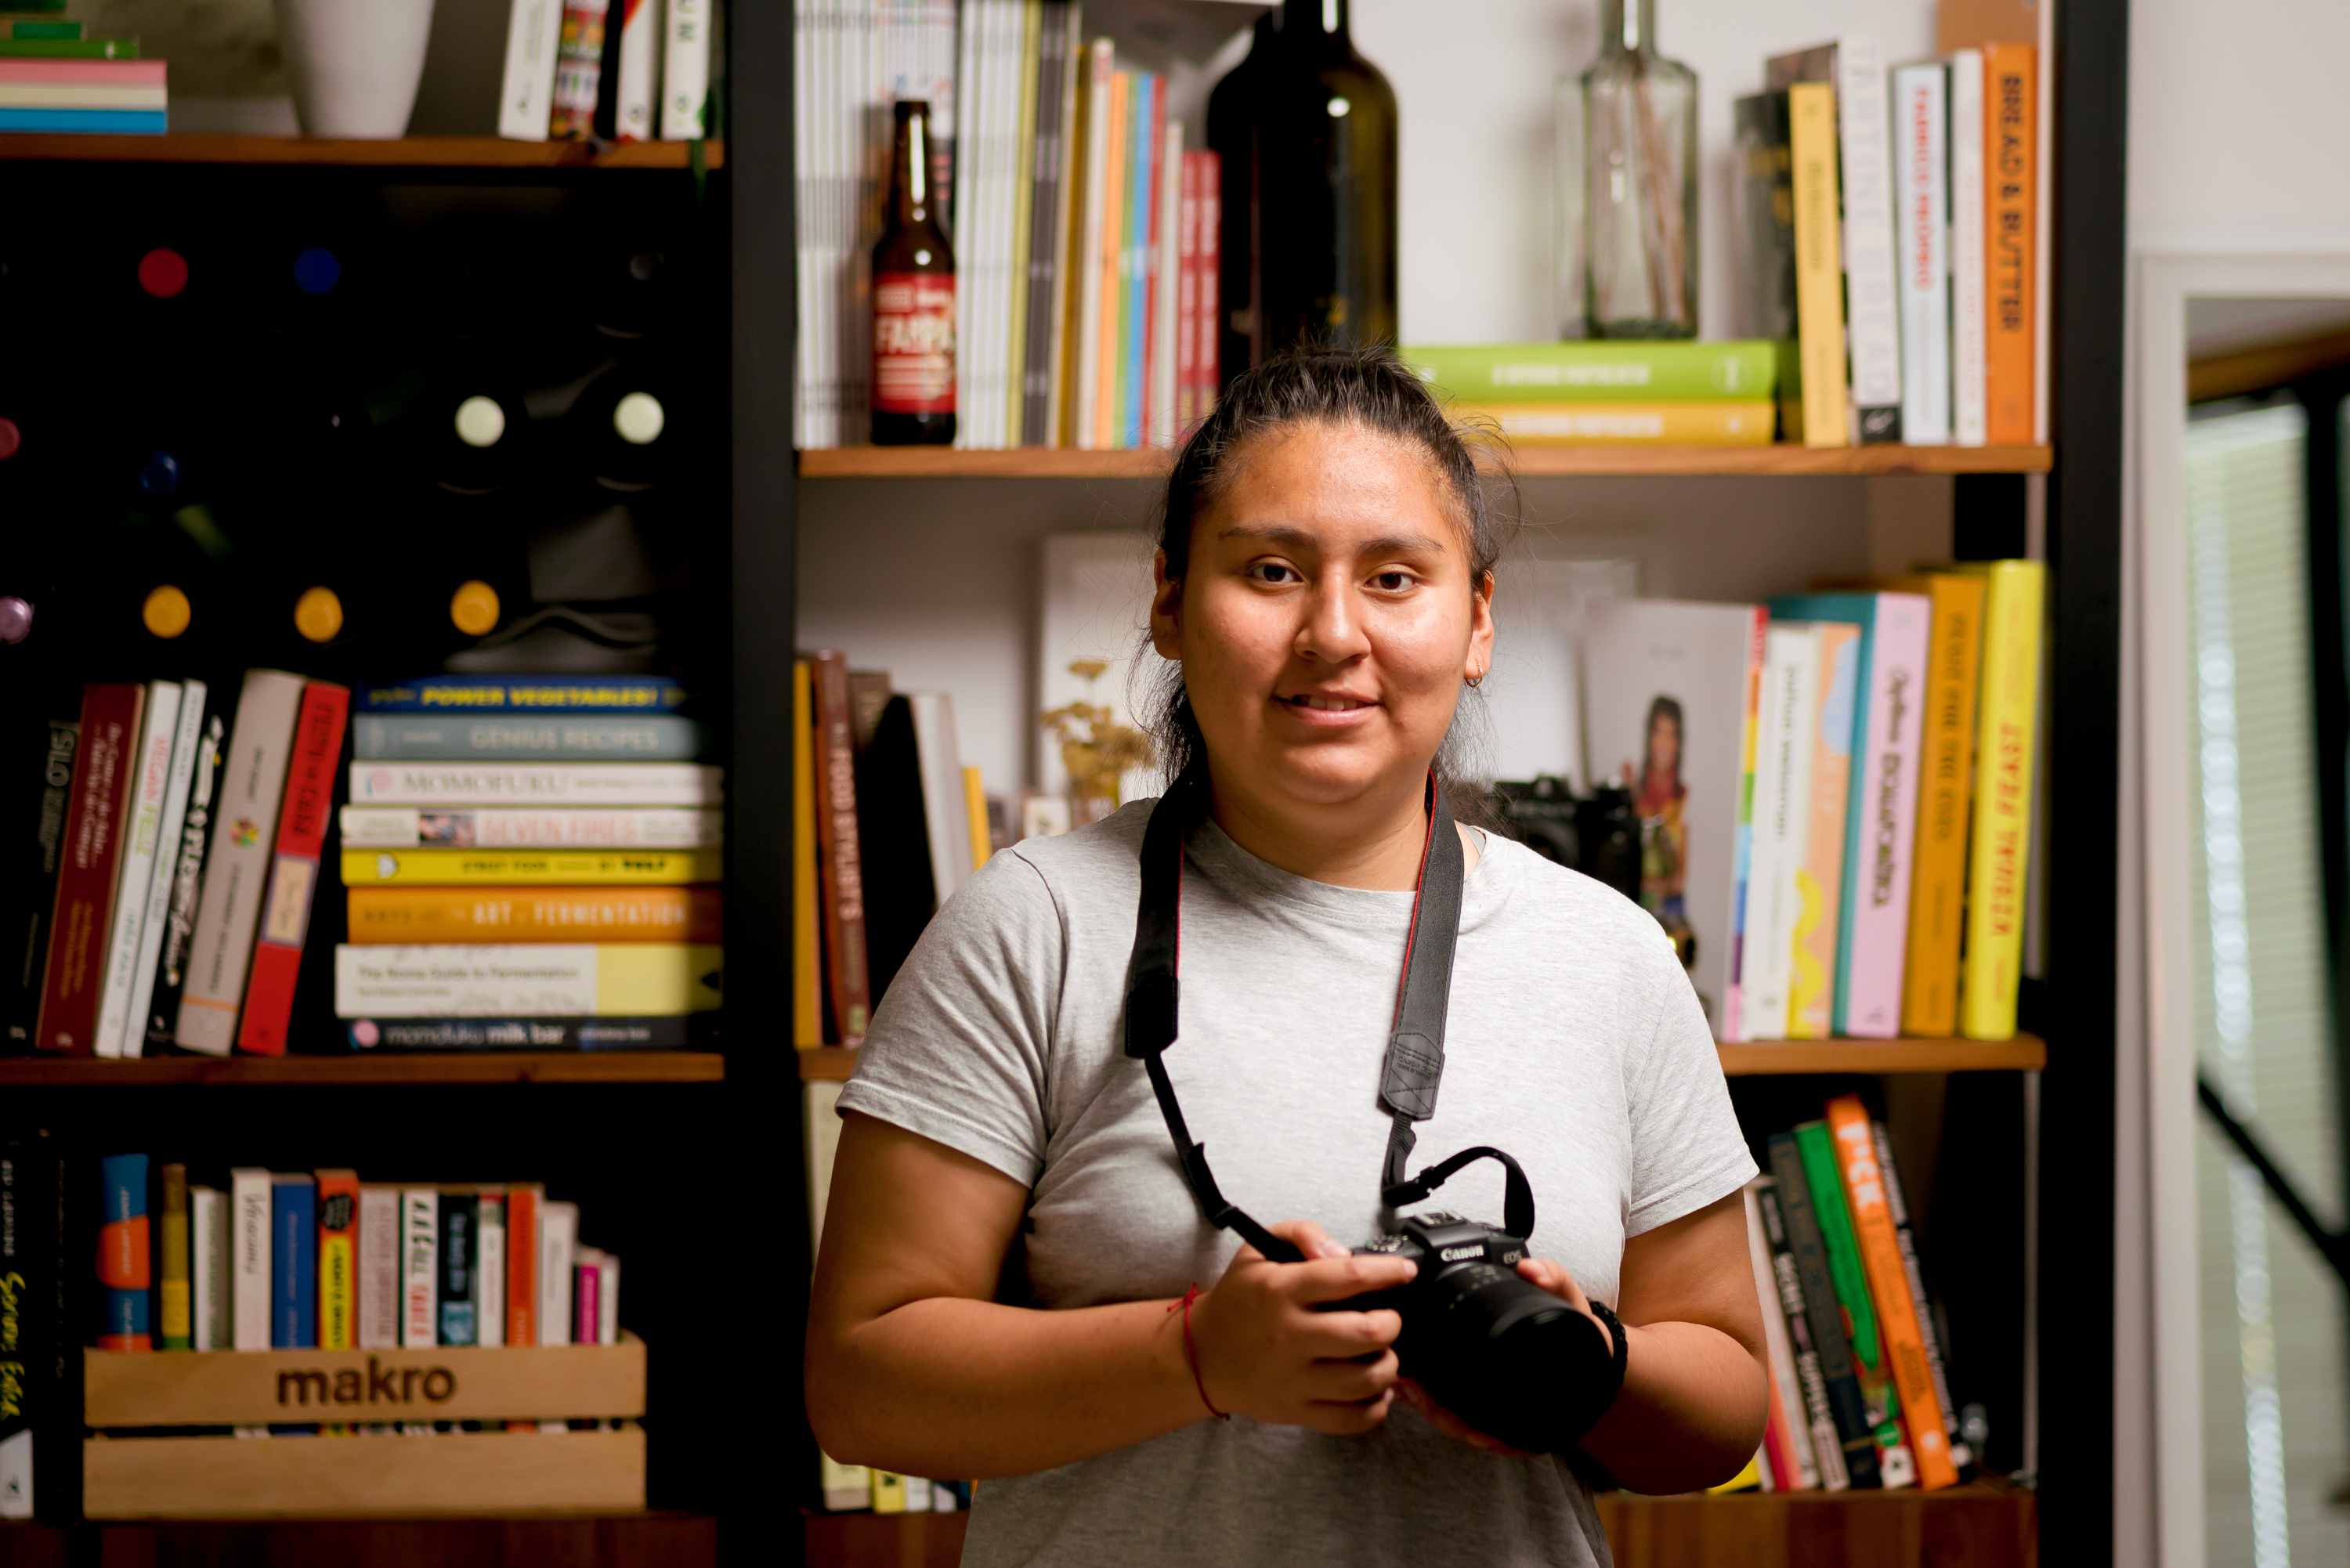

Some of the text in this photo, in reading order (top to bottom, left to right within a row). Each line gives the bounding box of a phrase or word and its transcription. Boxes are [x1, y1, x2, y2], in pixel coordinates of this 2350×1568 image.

[2001, 75, 2023, 177] BREAD
[2001, 212, 2024, 332] BUTTER
[421, 685, 505, 706] POWER
[509, 686, 657, 706] VEGETABLES!
[471, 725, 556, 750] GENIUS
[562, 726, 660, 750] RECIPES
[403, 769, 569, 797] MOMOFUKU
[533, 903, 686, 927] FERMENTATION
[385, 1021, 566, 1046] momofuku milk bar
[1441, 1245, 1522, 1264] Canon EOS
[277, 1356, 457, 1405] makro
